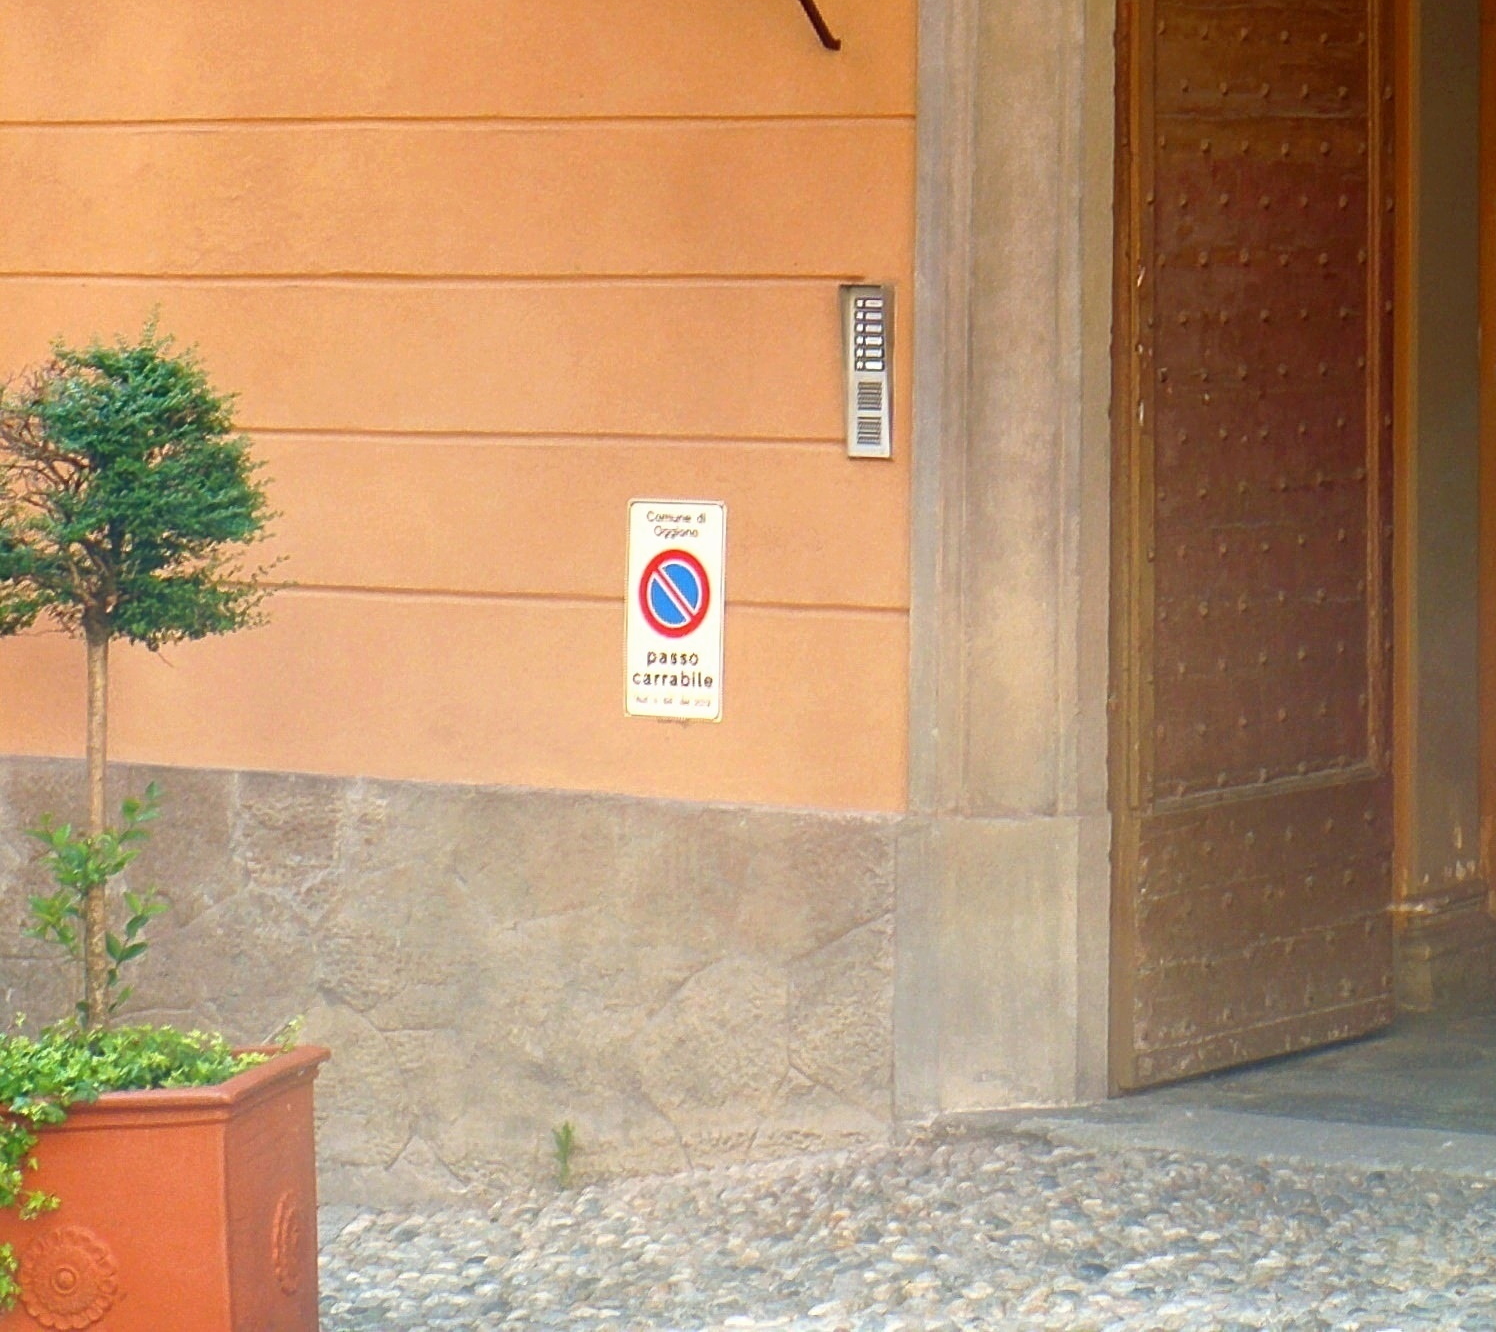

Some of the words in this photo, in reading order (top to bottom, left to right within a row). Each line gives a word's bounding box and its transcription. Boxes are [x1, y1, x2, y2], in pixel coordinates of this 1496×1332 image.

[646, 510, 692, 523] Comune
[696, 512, 707, 524] di
[646, 650, 700, 667] passo
[632, 670, 714, 689] carrabile
